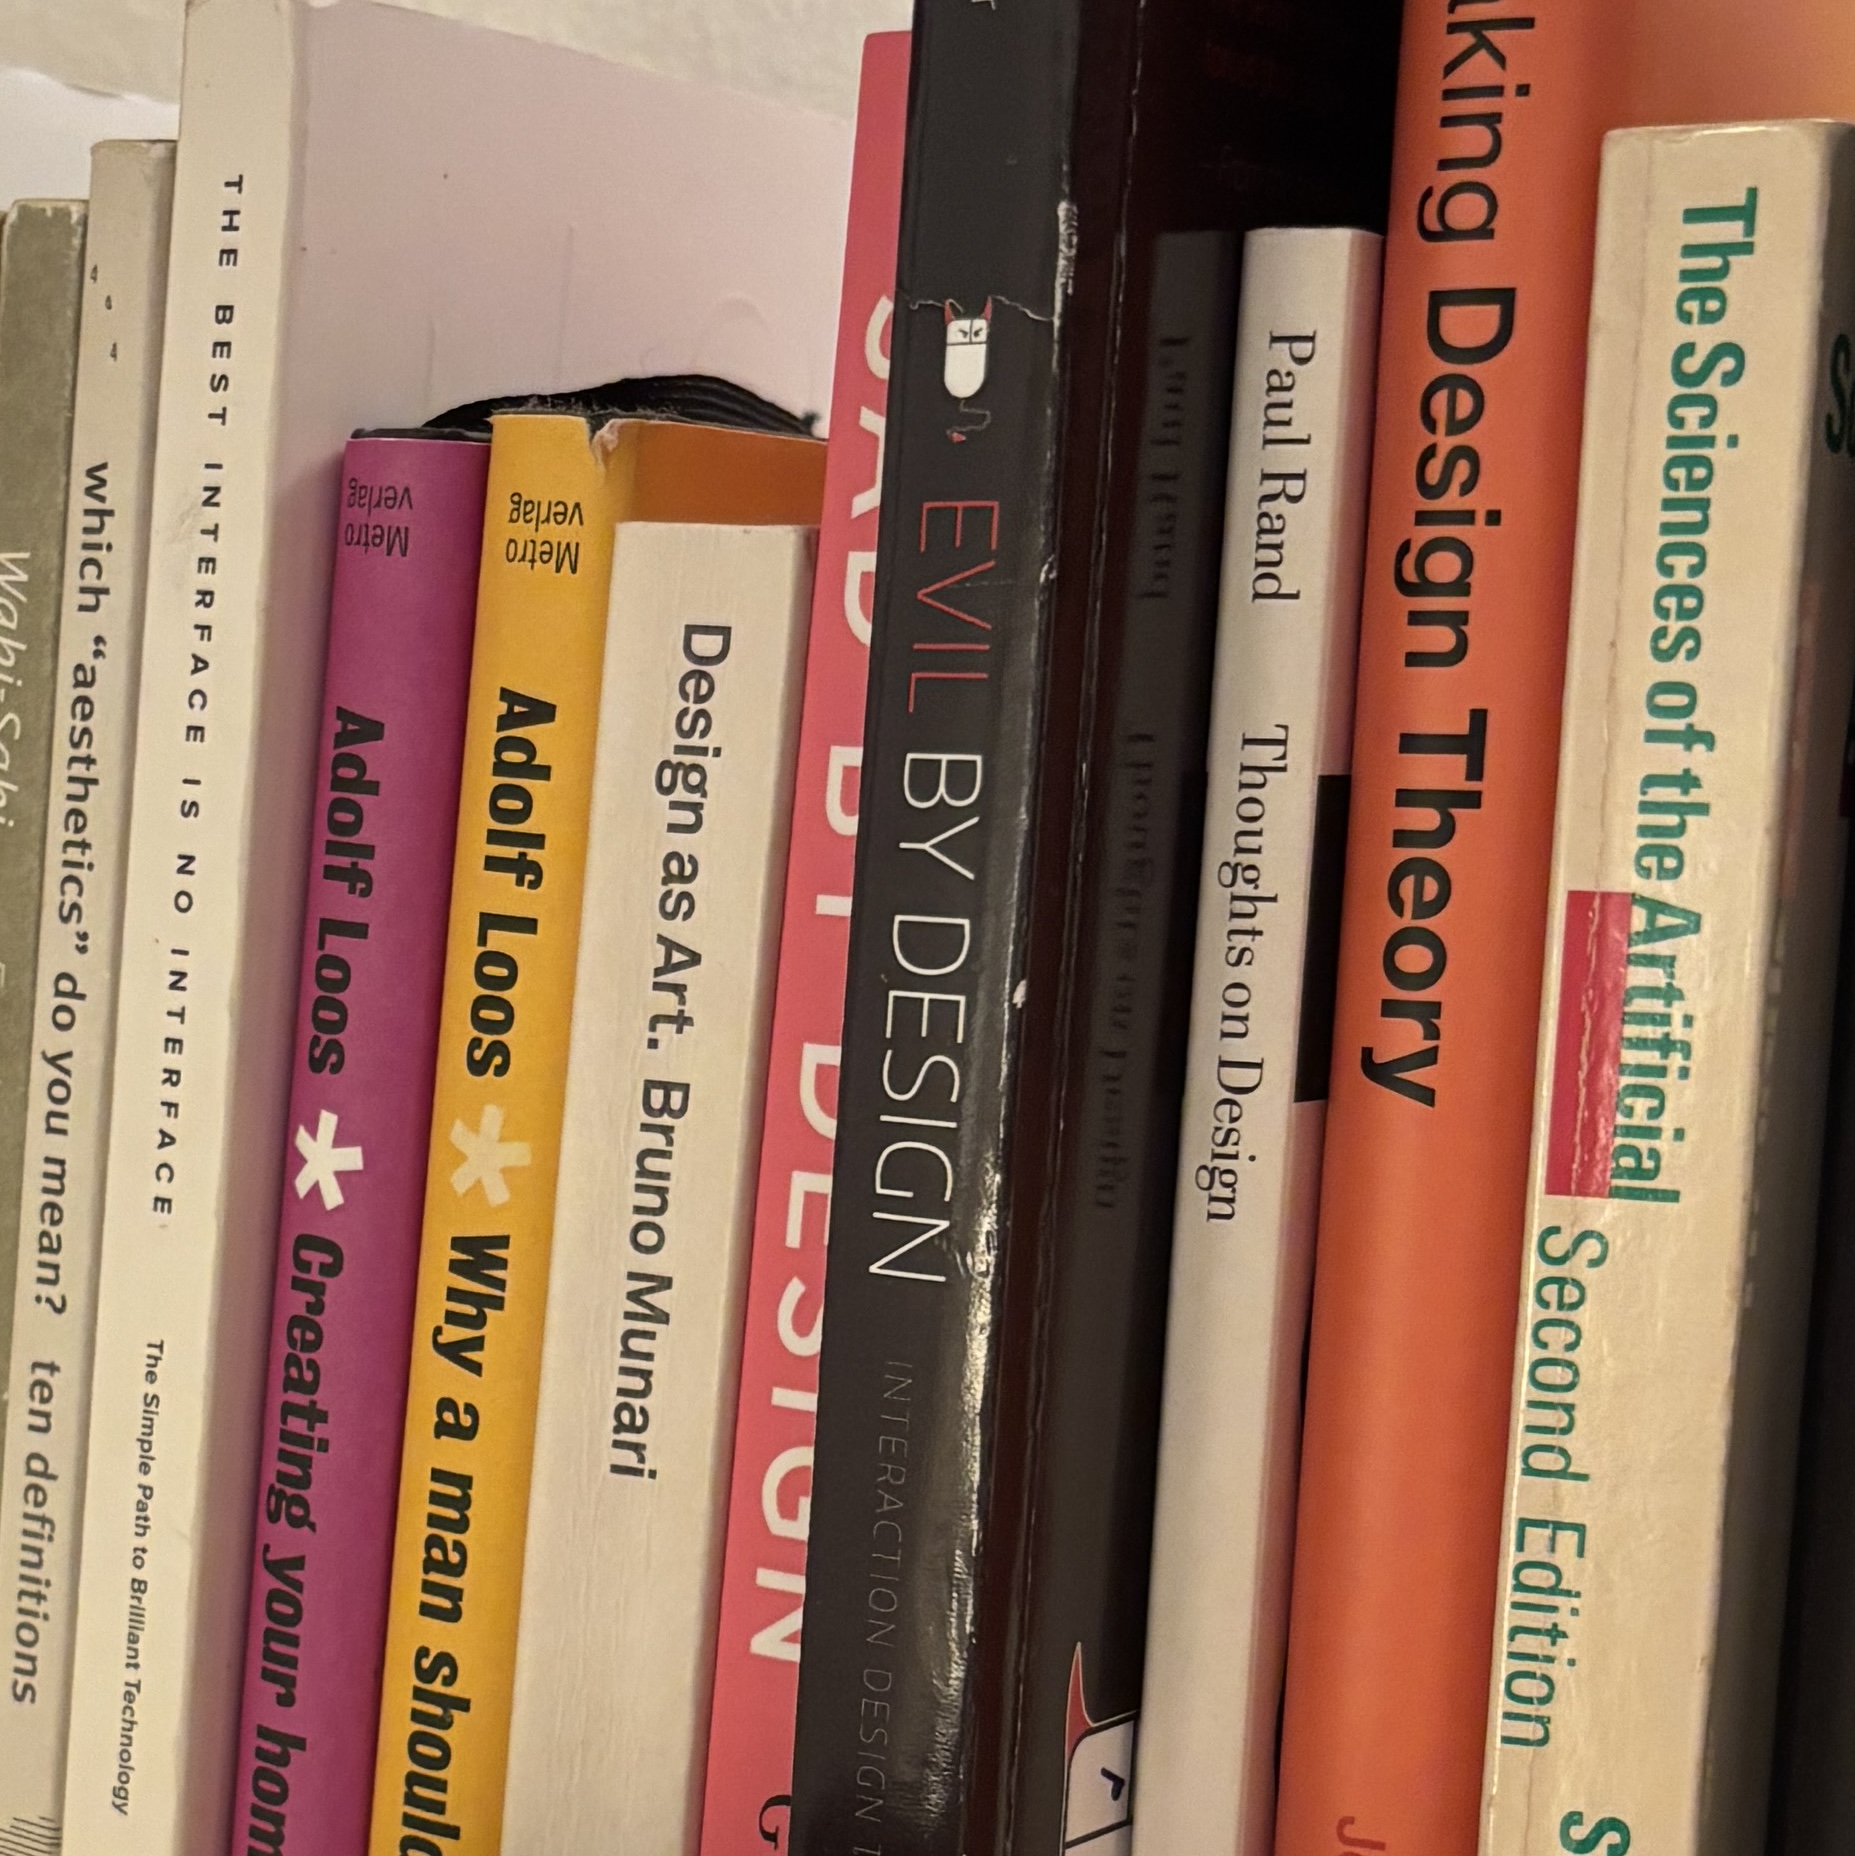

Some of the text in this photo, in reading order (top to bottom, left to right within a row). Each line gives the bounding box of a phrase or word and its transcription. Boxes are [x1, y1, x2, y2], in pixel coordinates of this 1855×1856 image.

[78, 461, 114, 614] which
[345, 526, 410, 556] Metro
[348, 477, 413, 509] verlag
[505, 541, 581, 574] Metro
[507, 491, 584, 526] verlag
[1360, 0, 1536, 1106] king Design Theory
[153, 174, 244, 1215] THE BEST INTERFACE IS NO INTERFACE
[1196, 329, 1318, 1222] Paul Rand Thoughts on Design
[1612, 186, 1759, 1203] The Sciences of the Artificial
[308, 707, 384, 1075] Adolf Loos
[467, 686, 557, 1077] Adolf Loos
[868, 501, 1000, 1283] EVIL BY DESIGN
[51, 972, 87, 1032] do
[610, 623, 731, 1479] Design as Art. Bruno Munari
[42, 1050, 79, 1136] you
[34, 1155, 70, 1314] mean?
[433, 1234, 510, 1377] Why
[27, 1361, 62, 1433] ten
[267, 1233, 344, 1533] Creating
[435, 1397, 481, 1438] a
[419, 1468, 474, 1623] man
[862, 1360, 916, 1646] INTERACTION
[1500, 1227, 1609, 1747] Second Edition
[12, 1452, 59, 1705] definitions
[112, 1341, 164, 1815] The Simple Path to Brilliant Technology
[257, 1545, 310, 1708] your
[854, 1667, 894, 1819] DESIGN
